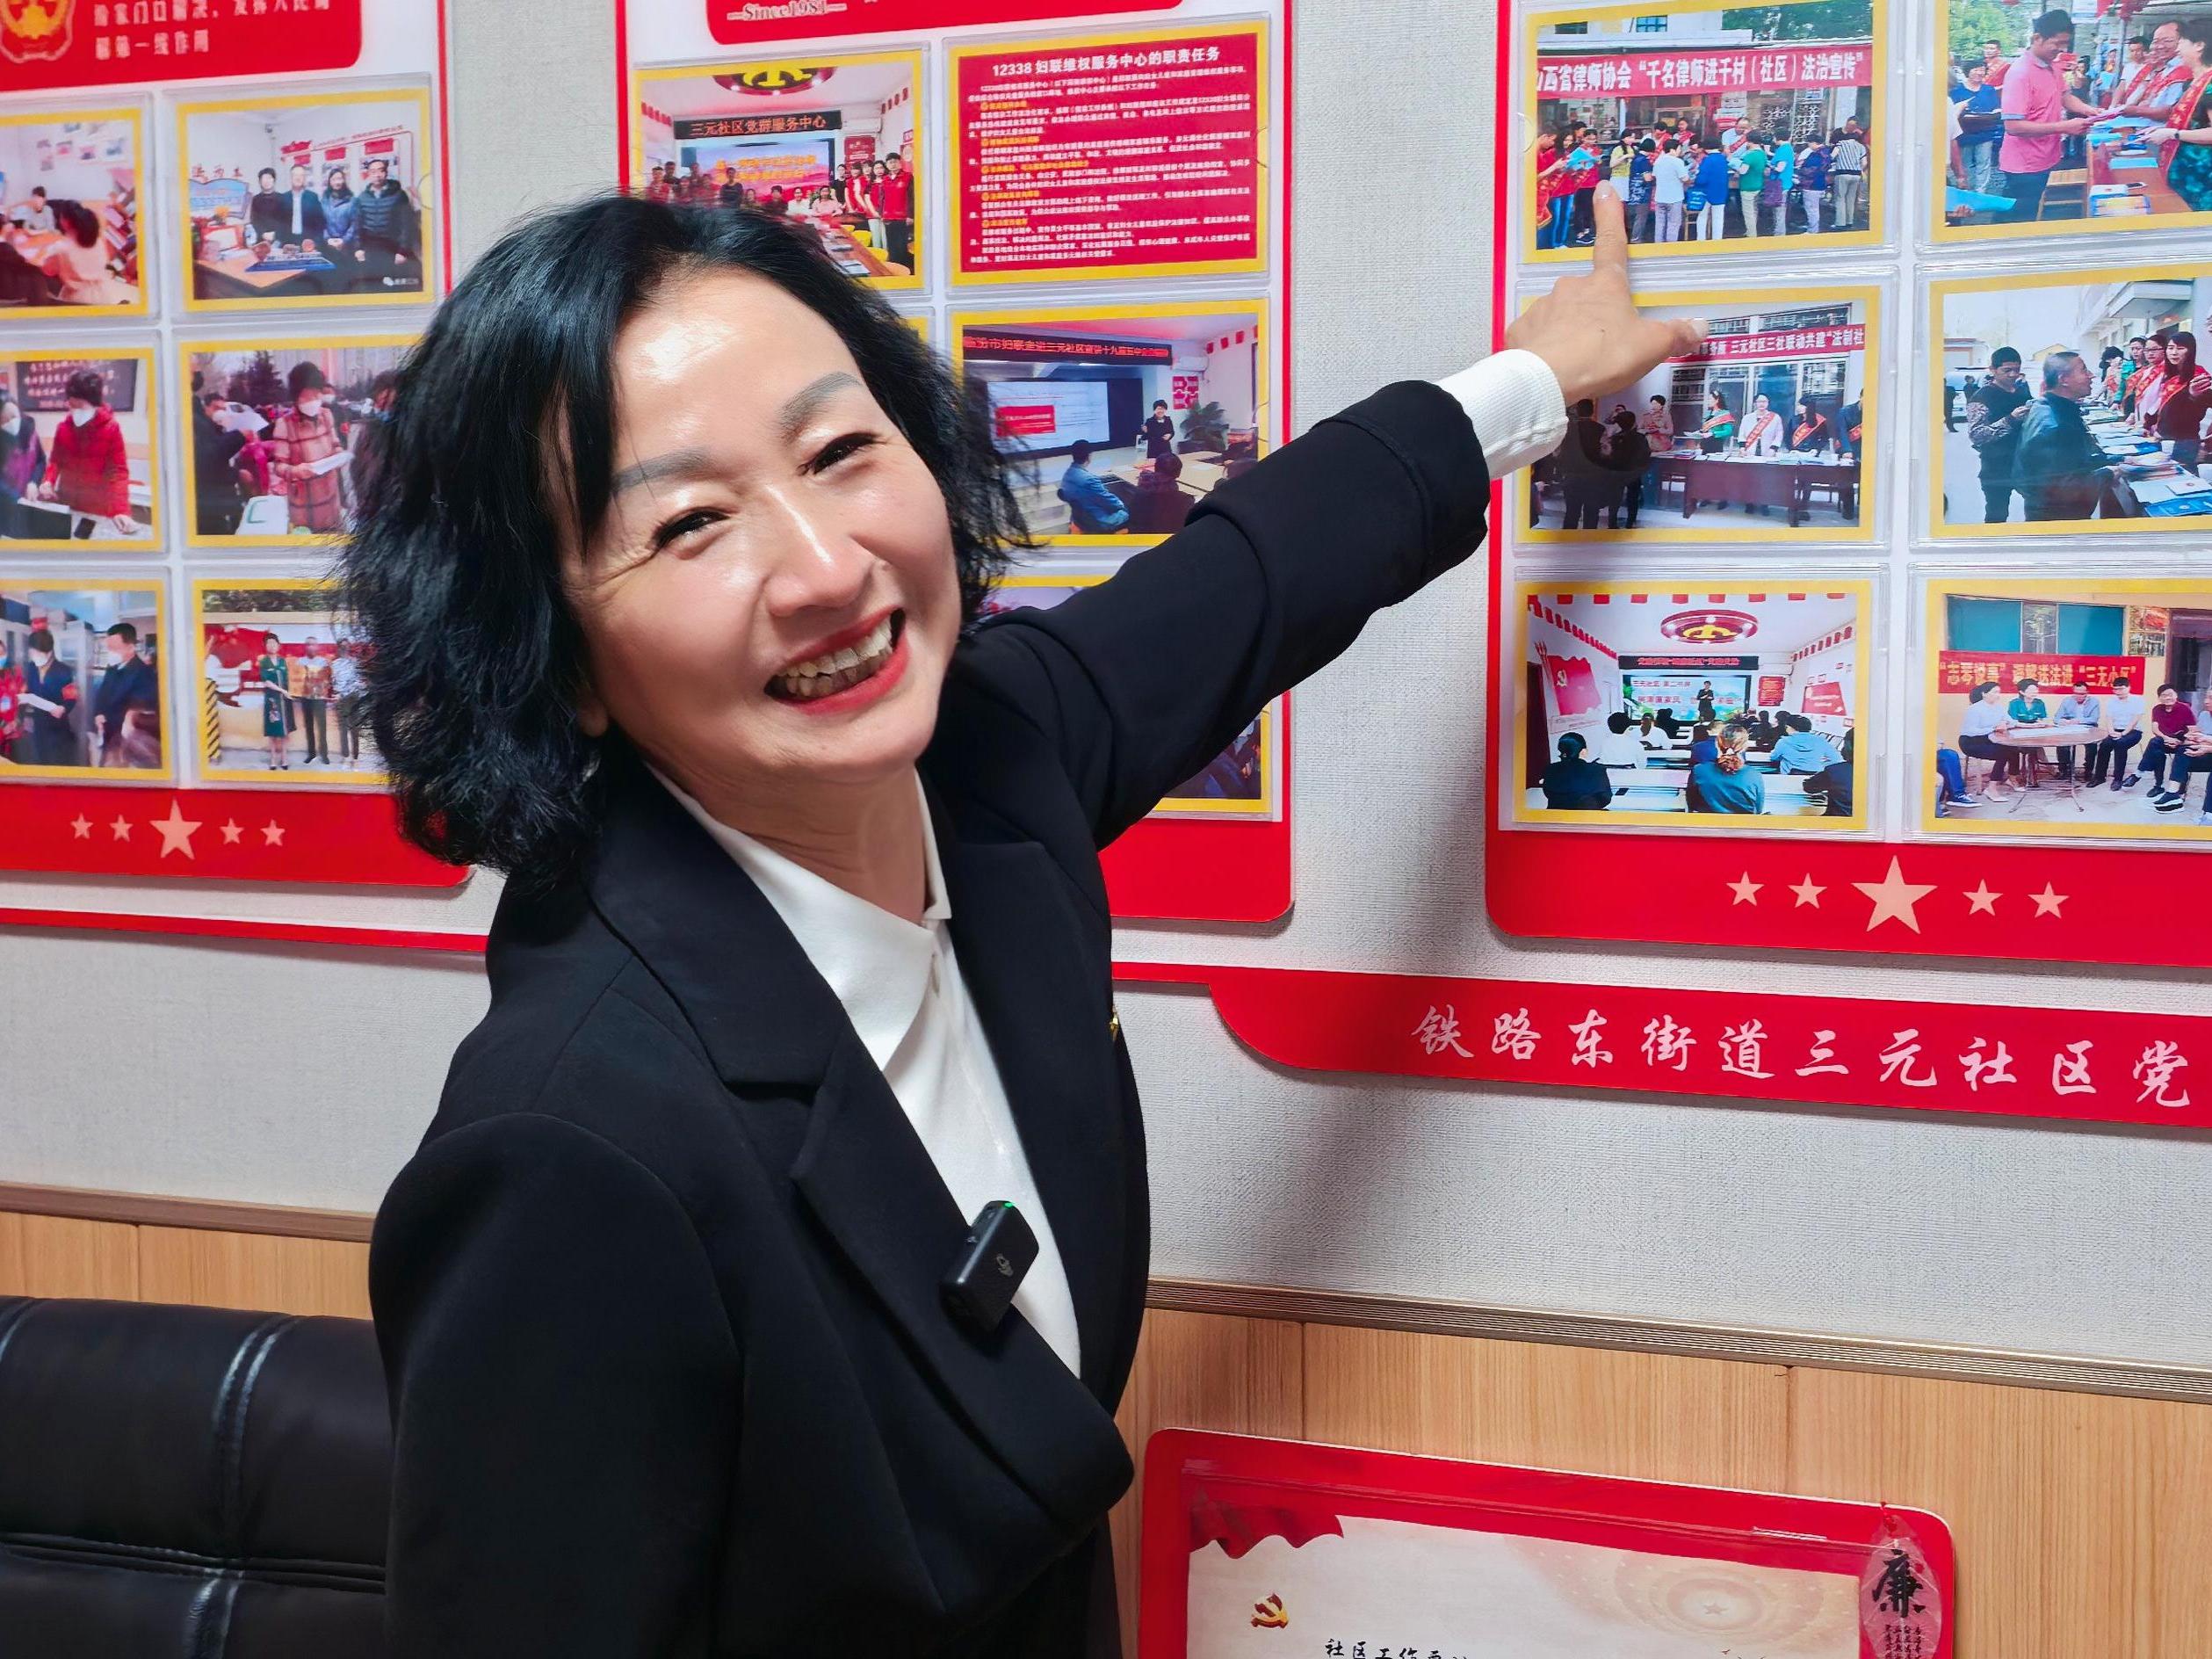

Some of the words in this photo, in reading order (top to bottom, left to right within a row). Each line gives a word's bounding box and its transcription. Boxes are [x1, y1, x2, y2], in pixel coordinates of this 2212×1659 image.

[993, 62, 1032, 77] 12338
[1036, 47, 1220, 74] 妇联维权服务中心的职责任务
[689, 113, 828, 137] 三元社区党群服务中心
[1411, 1003, 2192, 1108] 铁路东街道三元社区党
[1872, 1549, 1926, 1618] 廉
